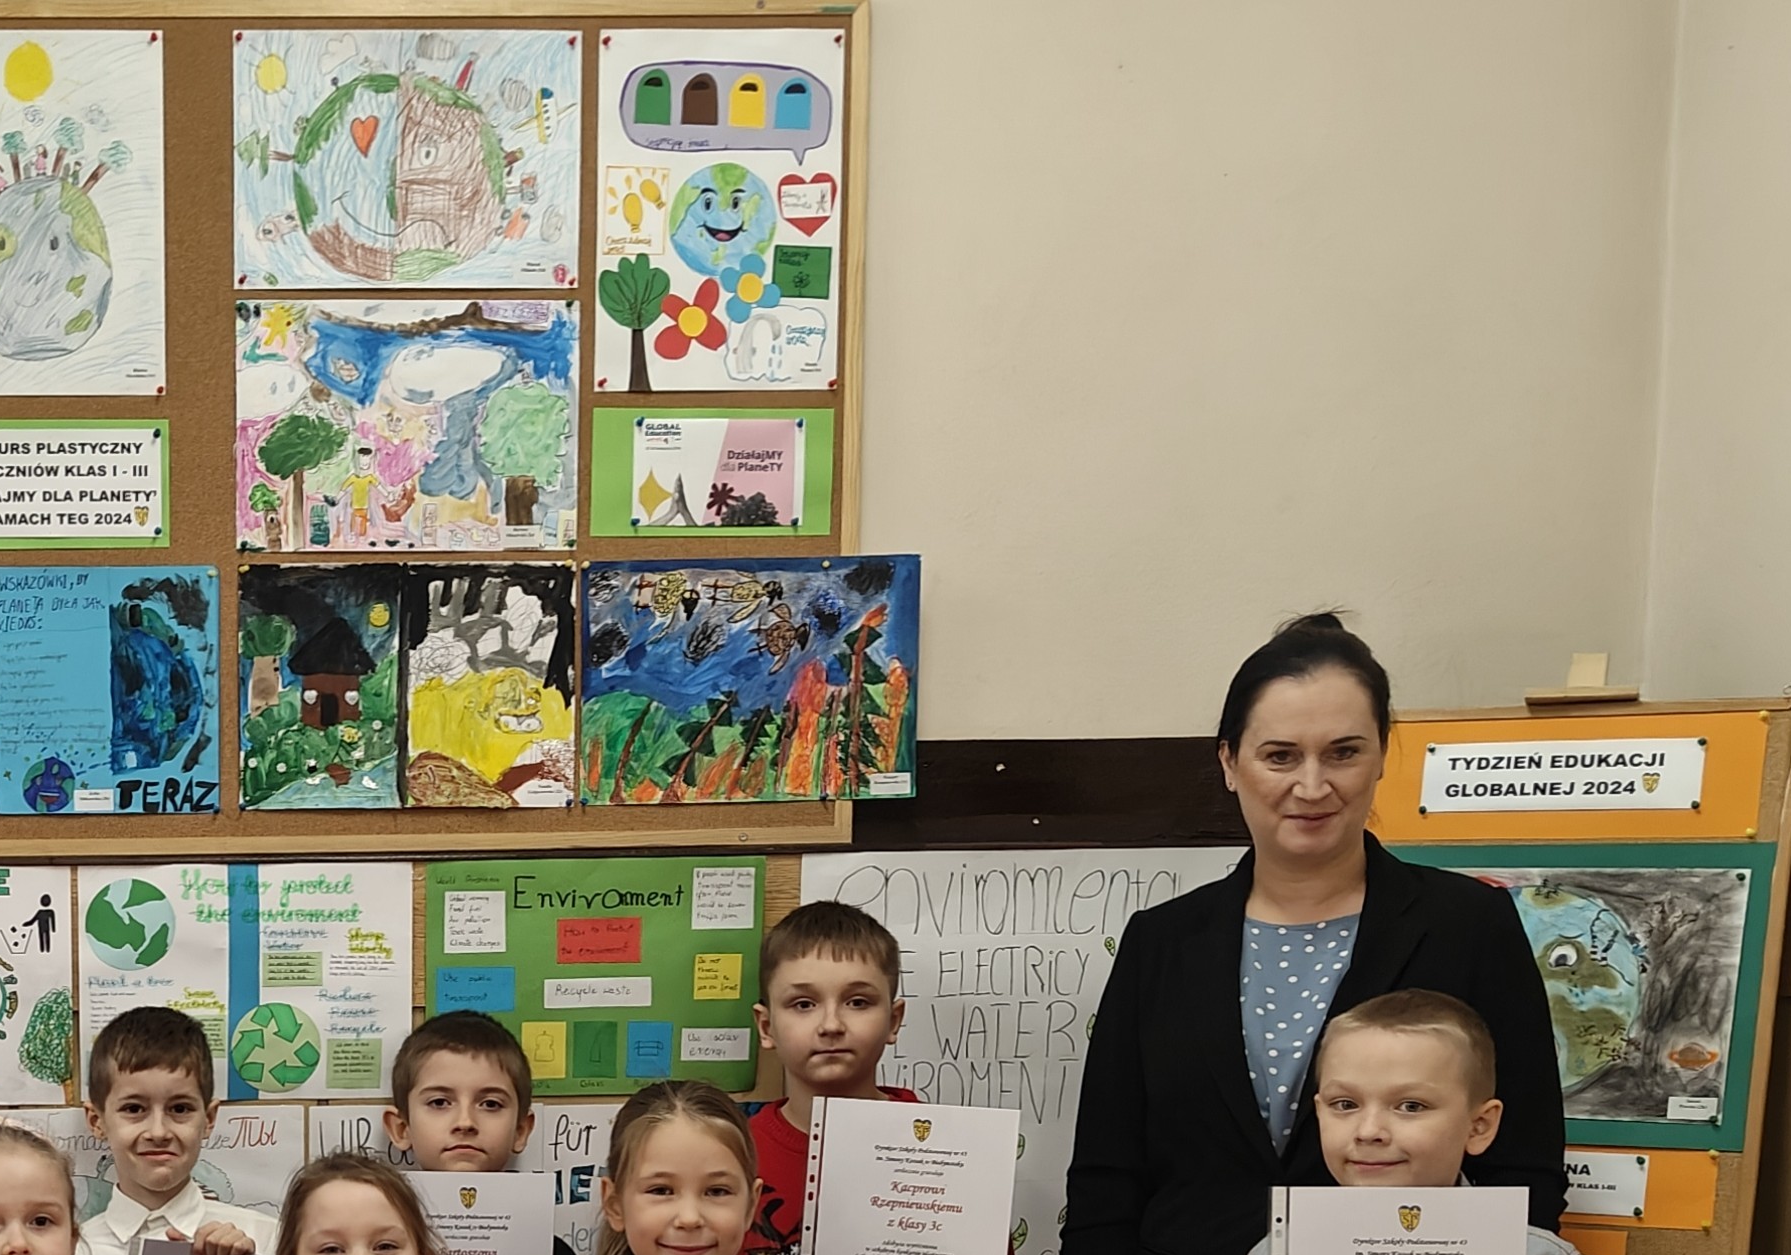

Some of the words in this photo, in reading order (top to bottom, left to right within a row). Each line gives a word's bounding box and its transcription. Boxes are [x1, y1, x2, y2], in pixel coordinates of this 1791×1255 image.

[36, 442, 143, 454] PLASTYCZNY
[727, 450, 783, 461] DziałajMY
[64, 465, 107, 477] KLAS
[133, 465, 148, 476] III
[737, 461, 783, 472] PlaneTY
[42, 491, 74, 502] DLA
[57, 514, 89, 525] TEG
[95, 513, 132, 524] 2024
[82, 598, 106, 610] JAK
[1448, 752, 1543, 772] TYDZIEŃ
[1550, 752, 1666, 769] EDUKACJI
[116, 776, 219, 812] TERAZ
[1445, 782, 1576, 798] GLOBALNEJ
[1582, 781, 1636, 796] 2024
[934, 946, 1090, 999] ELECTRICY
[931, 1001, 1079, 1061] WATER
[890, 1181, 947, 1196] Kacprowi
[870, 1196, 964, 1214] Rzepniewskiemu
[897, 1217, 927, 1233] klasy
[930, 1220, 943, 1231] 3c
